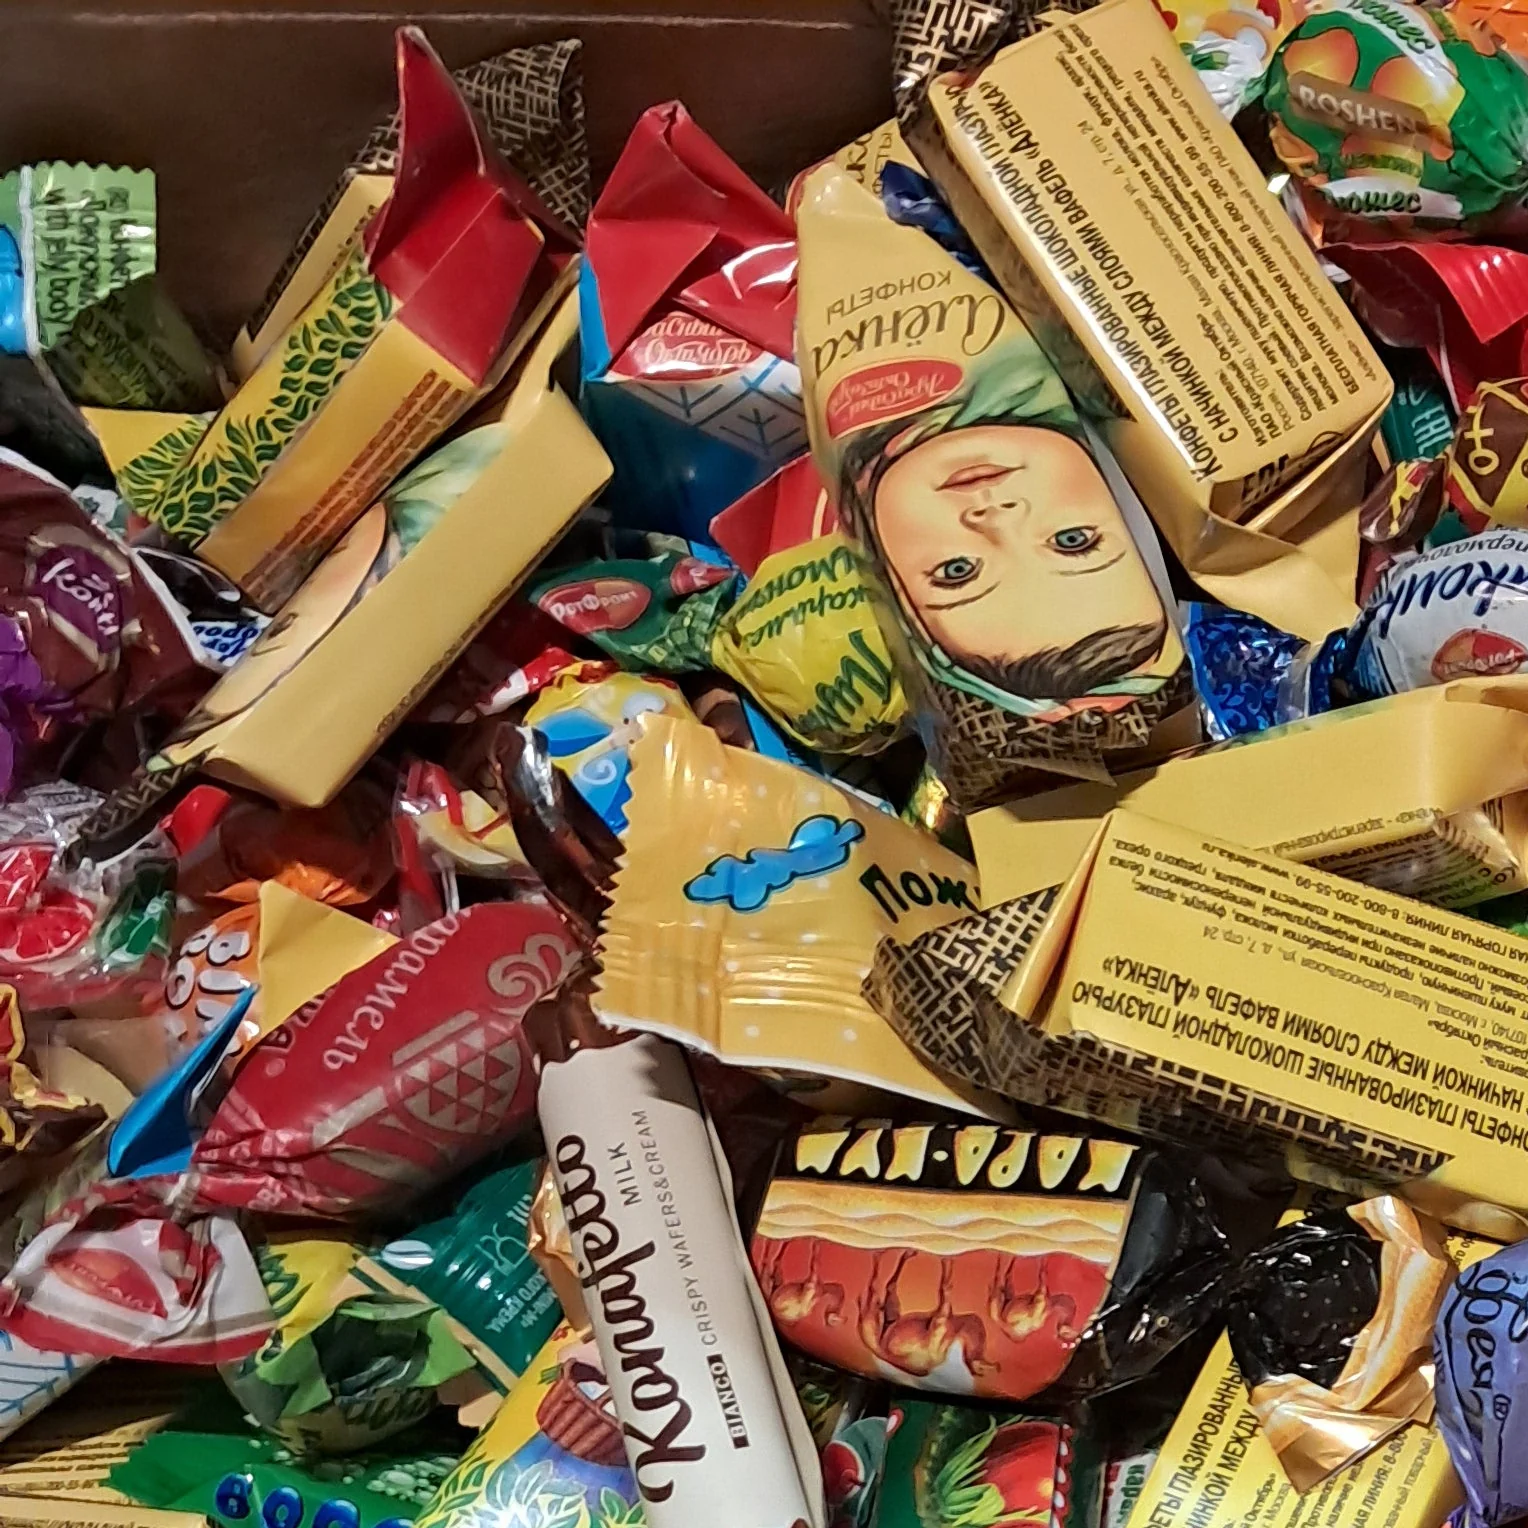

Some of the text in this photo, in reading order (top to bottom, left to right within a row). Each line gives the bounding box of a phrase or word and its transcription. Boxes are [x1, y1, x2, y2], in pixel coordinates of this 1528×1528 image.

[985, 152, 1084, 275] ШОКОЛАДНОЙ
[967, 74, 1242, 446] С НАЧИНКОЙ МЕЖДУ СЛОЯМИ ВАФЕЛЬ «АЛЁНКА»
[825, 268, 953, 322] КОНФЕТЫ
[1270, 270, 1315, 325] ГОРЯЧАЯ
[812, 292, 1007, 379] Алёнка
[1063, 262, 1171, 401] ГЛАЗИРОВАННЫЕ
[1303, 319, 1362, 395] БЕСПЛАТНАЯ
[1145, 389, 1226, 484] КОНФЕТЫ
[1258, 409, 1285, 439] ПАО
[1069, 977, 1171, 1034] ГЛАЗУРЬЮ
[1097, 947, 1203, 1011] «АЛЁНКА»
[1200, 983, 1280, 1031] ВАФЕЛЬ
[1168, 1006, 1306, 1081] ШОКОЛАДНОЙ
[1278, 1009, 1362, 1058] СЛОЯМИ
[1360, 1034, 1433, 1082] МЕЖДУ
[1301, 1052, 1460, 1129] ГЛАЗИРОВАННЫЕ
[1428, 1061, 1526, 1119] НАЧИНКОЙ
[622, 1142, 644, 1206] MILK
[635, 1108, 749, 1449] BIANCO CRISPY WAFERS&CREAM
[555, 1133, 707, 1504] Konafetto
[1215, 1408, 1265, 1474] МЕЖДУ
